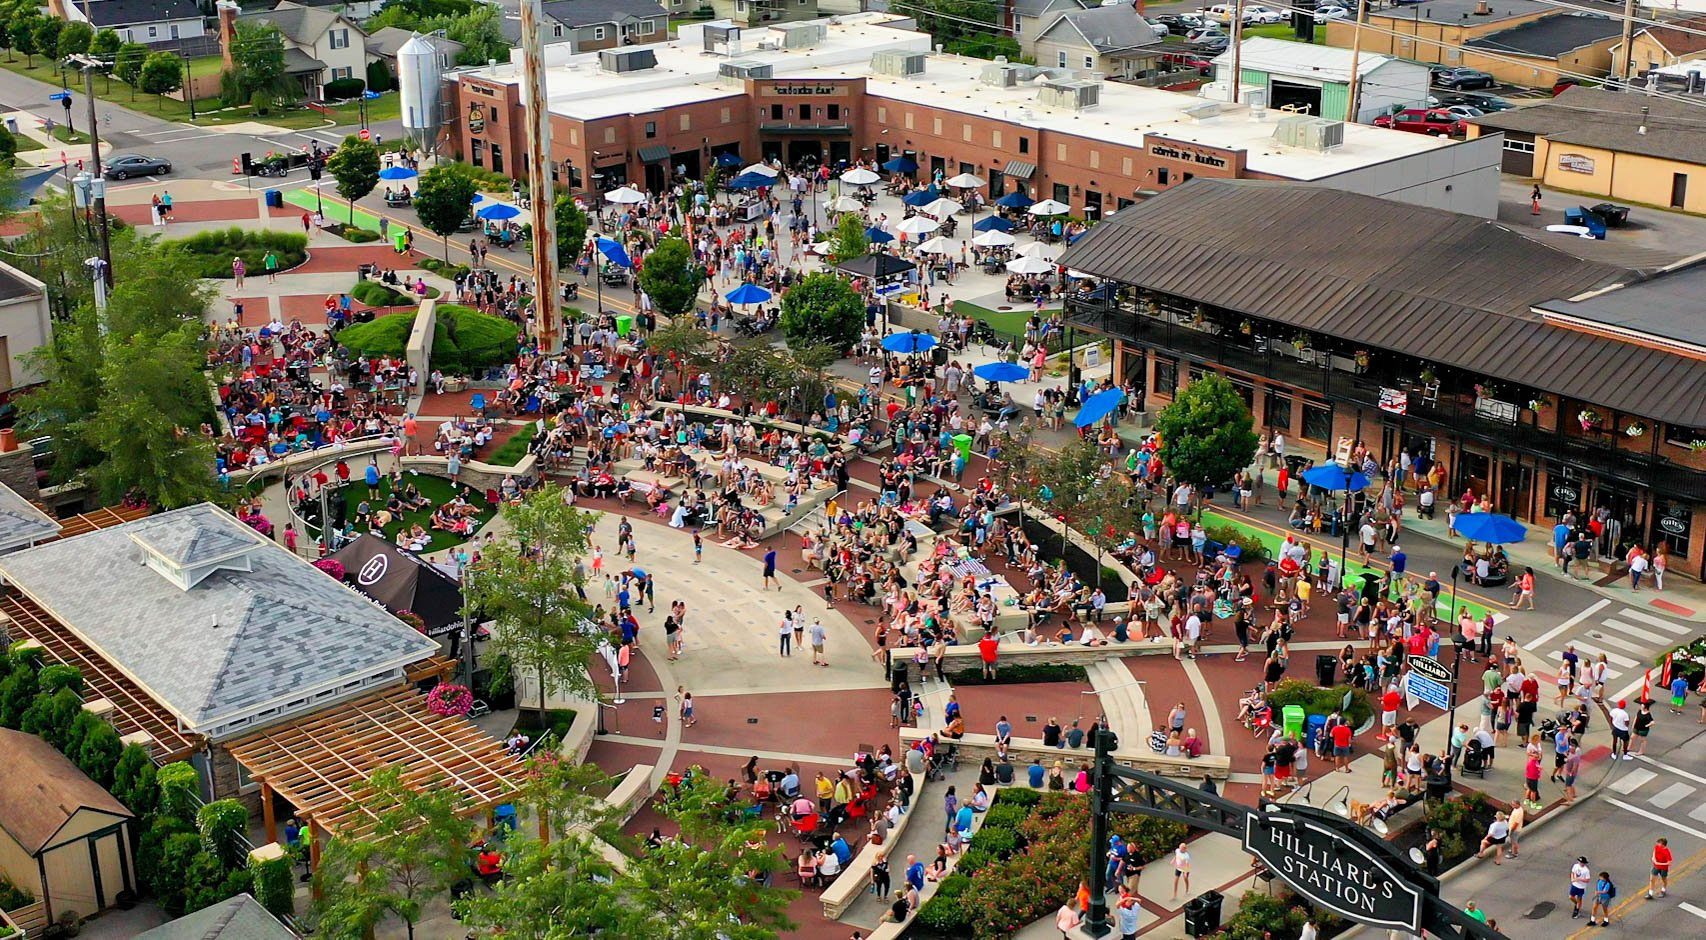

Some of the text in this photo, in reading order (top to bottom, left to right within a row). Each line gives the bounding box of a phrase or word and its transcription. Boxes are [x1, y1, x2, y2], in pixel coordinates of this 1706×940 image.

[362, 559, 383, 580] H
[1412, 658, 1447, 678] HILLIARD
[1270, 826, 1393, 899] HILLIARDS
[1283, 855, 1376, 913] STATION
